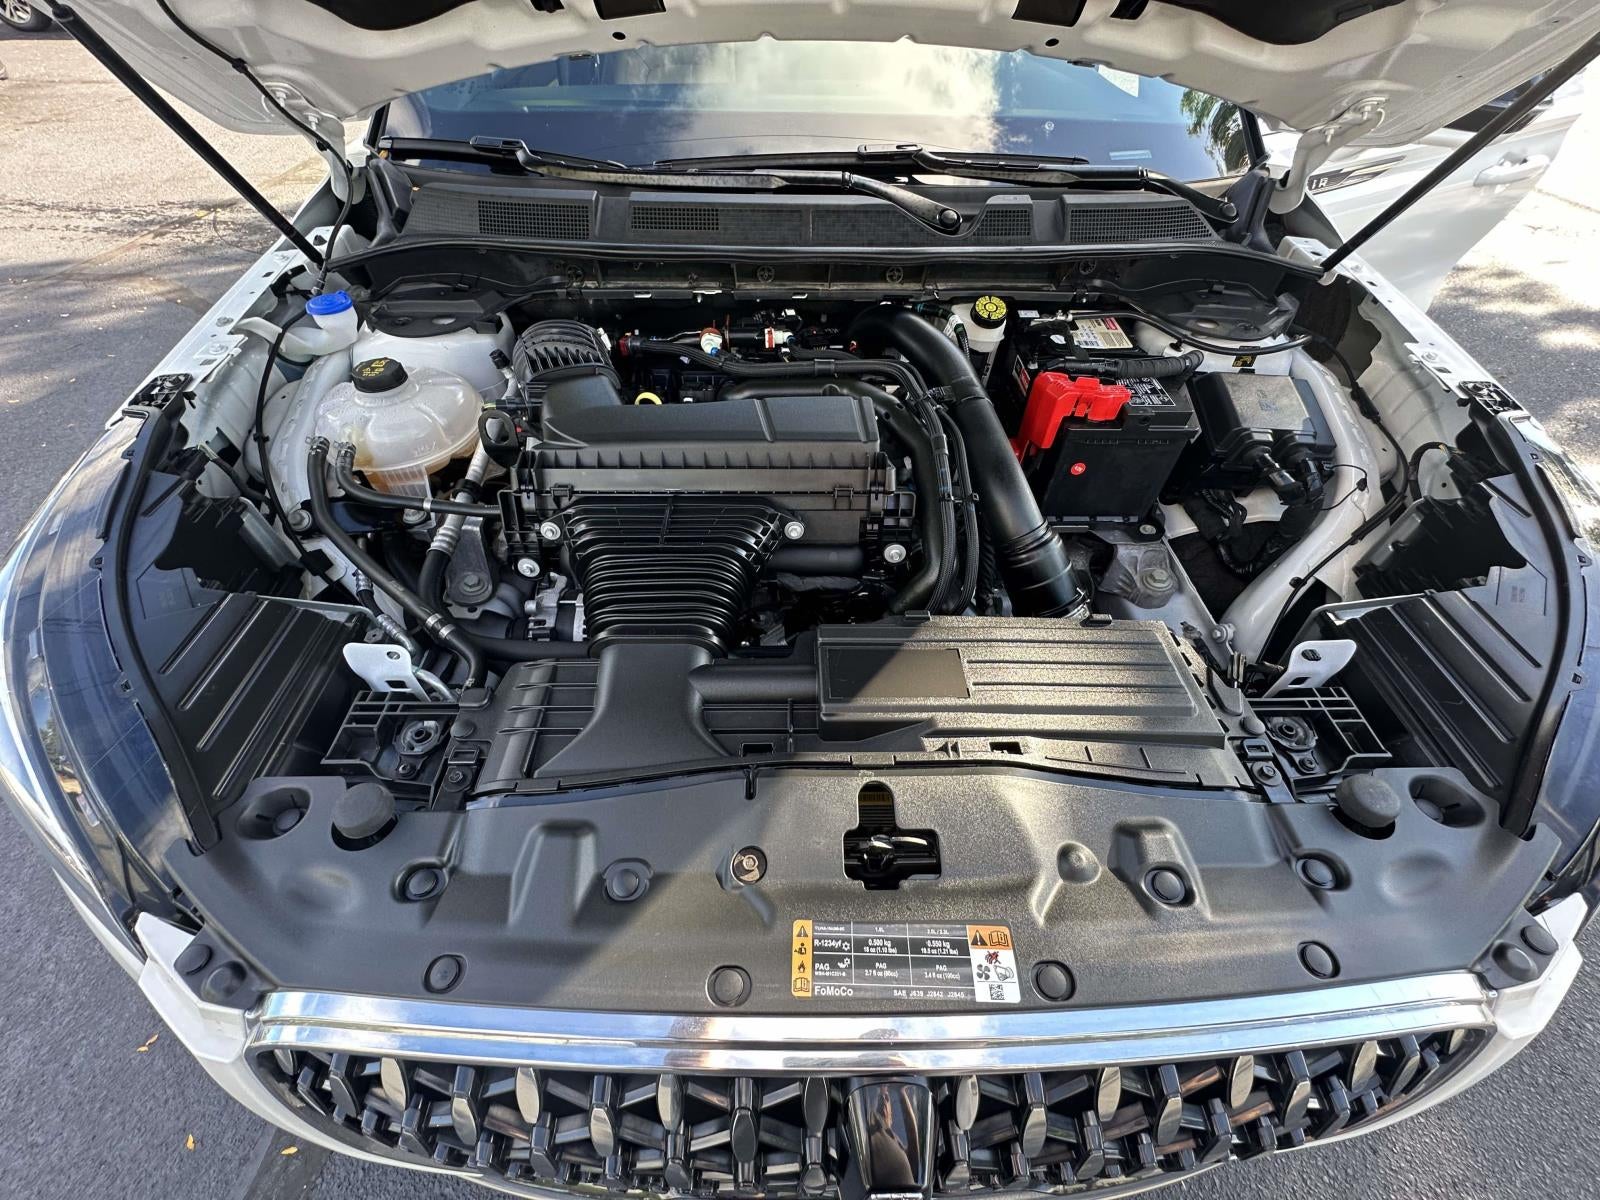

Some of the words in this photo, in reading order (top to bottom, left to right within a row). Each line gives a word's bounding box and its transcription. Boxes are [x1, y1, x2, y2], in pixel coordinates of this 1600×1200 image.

[813, 938, 842, 947] R-1234yf
[884, 938, 892, 948] kg
[942, 940, 950, 950] kg
[814, 962, 830, 970] PAG
[814, 985, 854, 997] FoMoCo
